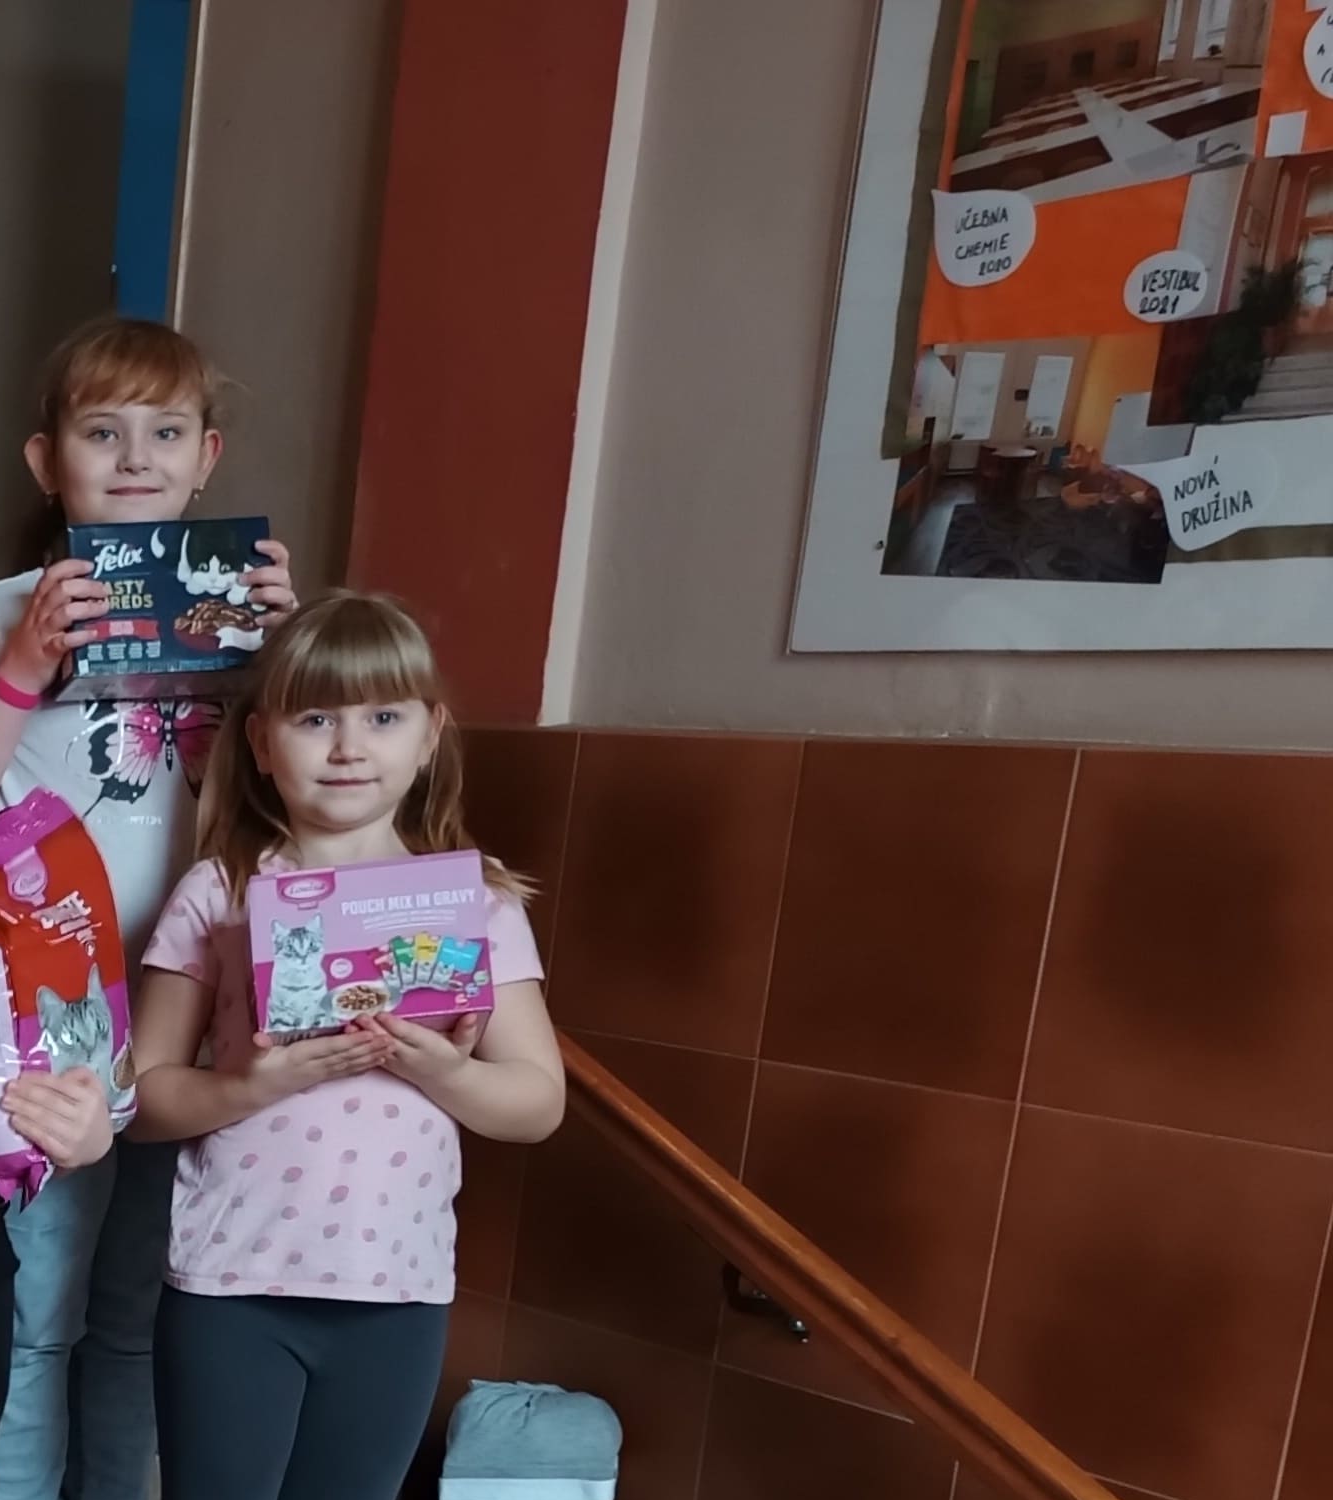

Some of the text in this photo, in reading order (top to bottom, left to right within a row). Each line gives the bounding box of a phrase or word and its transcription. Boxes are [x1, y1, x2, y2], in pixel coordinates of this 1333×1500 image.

[954, 207, 1009, 234] UČEBNA
[954, 232, 1010, 260] CHEMIE
[978, 256, 1012, 276] 2020
[1141, 269, 1200, 294] VESTIBUL
[1138, 295, 1179, 314] 2021
[1173, 455, 1220, 501] NOVÁ
[1181, 489, 1254, 533] DRUŽINA
[92, 543, 144, 579] felix
[341, 888, 476, 916] POUCH MIX IN GRAVY
